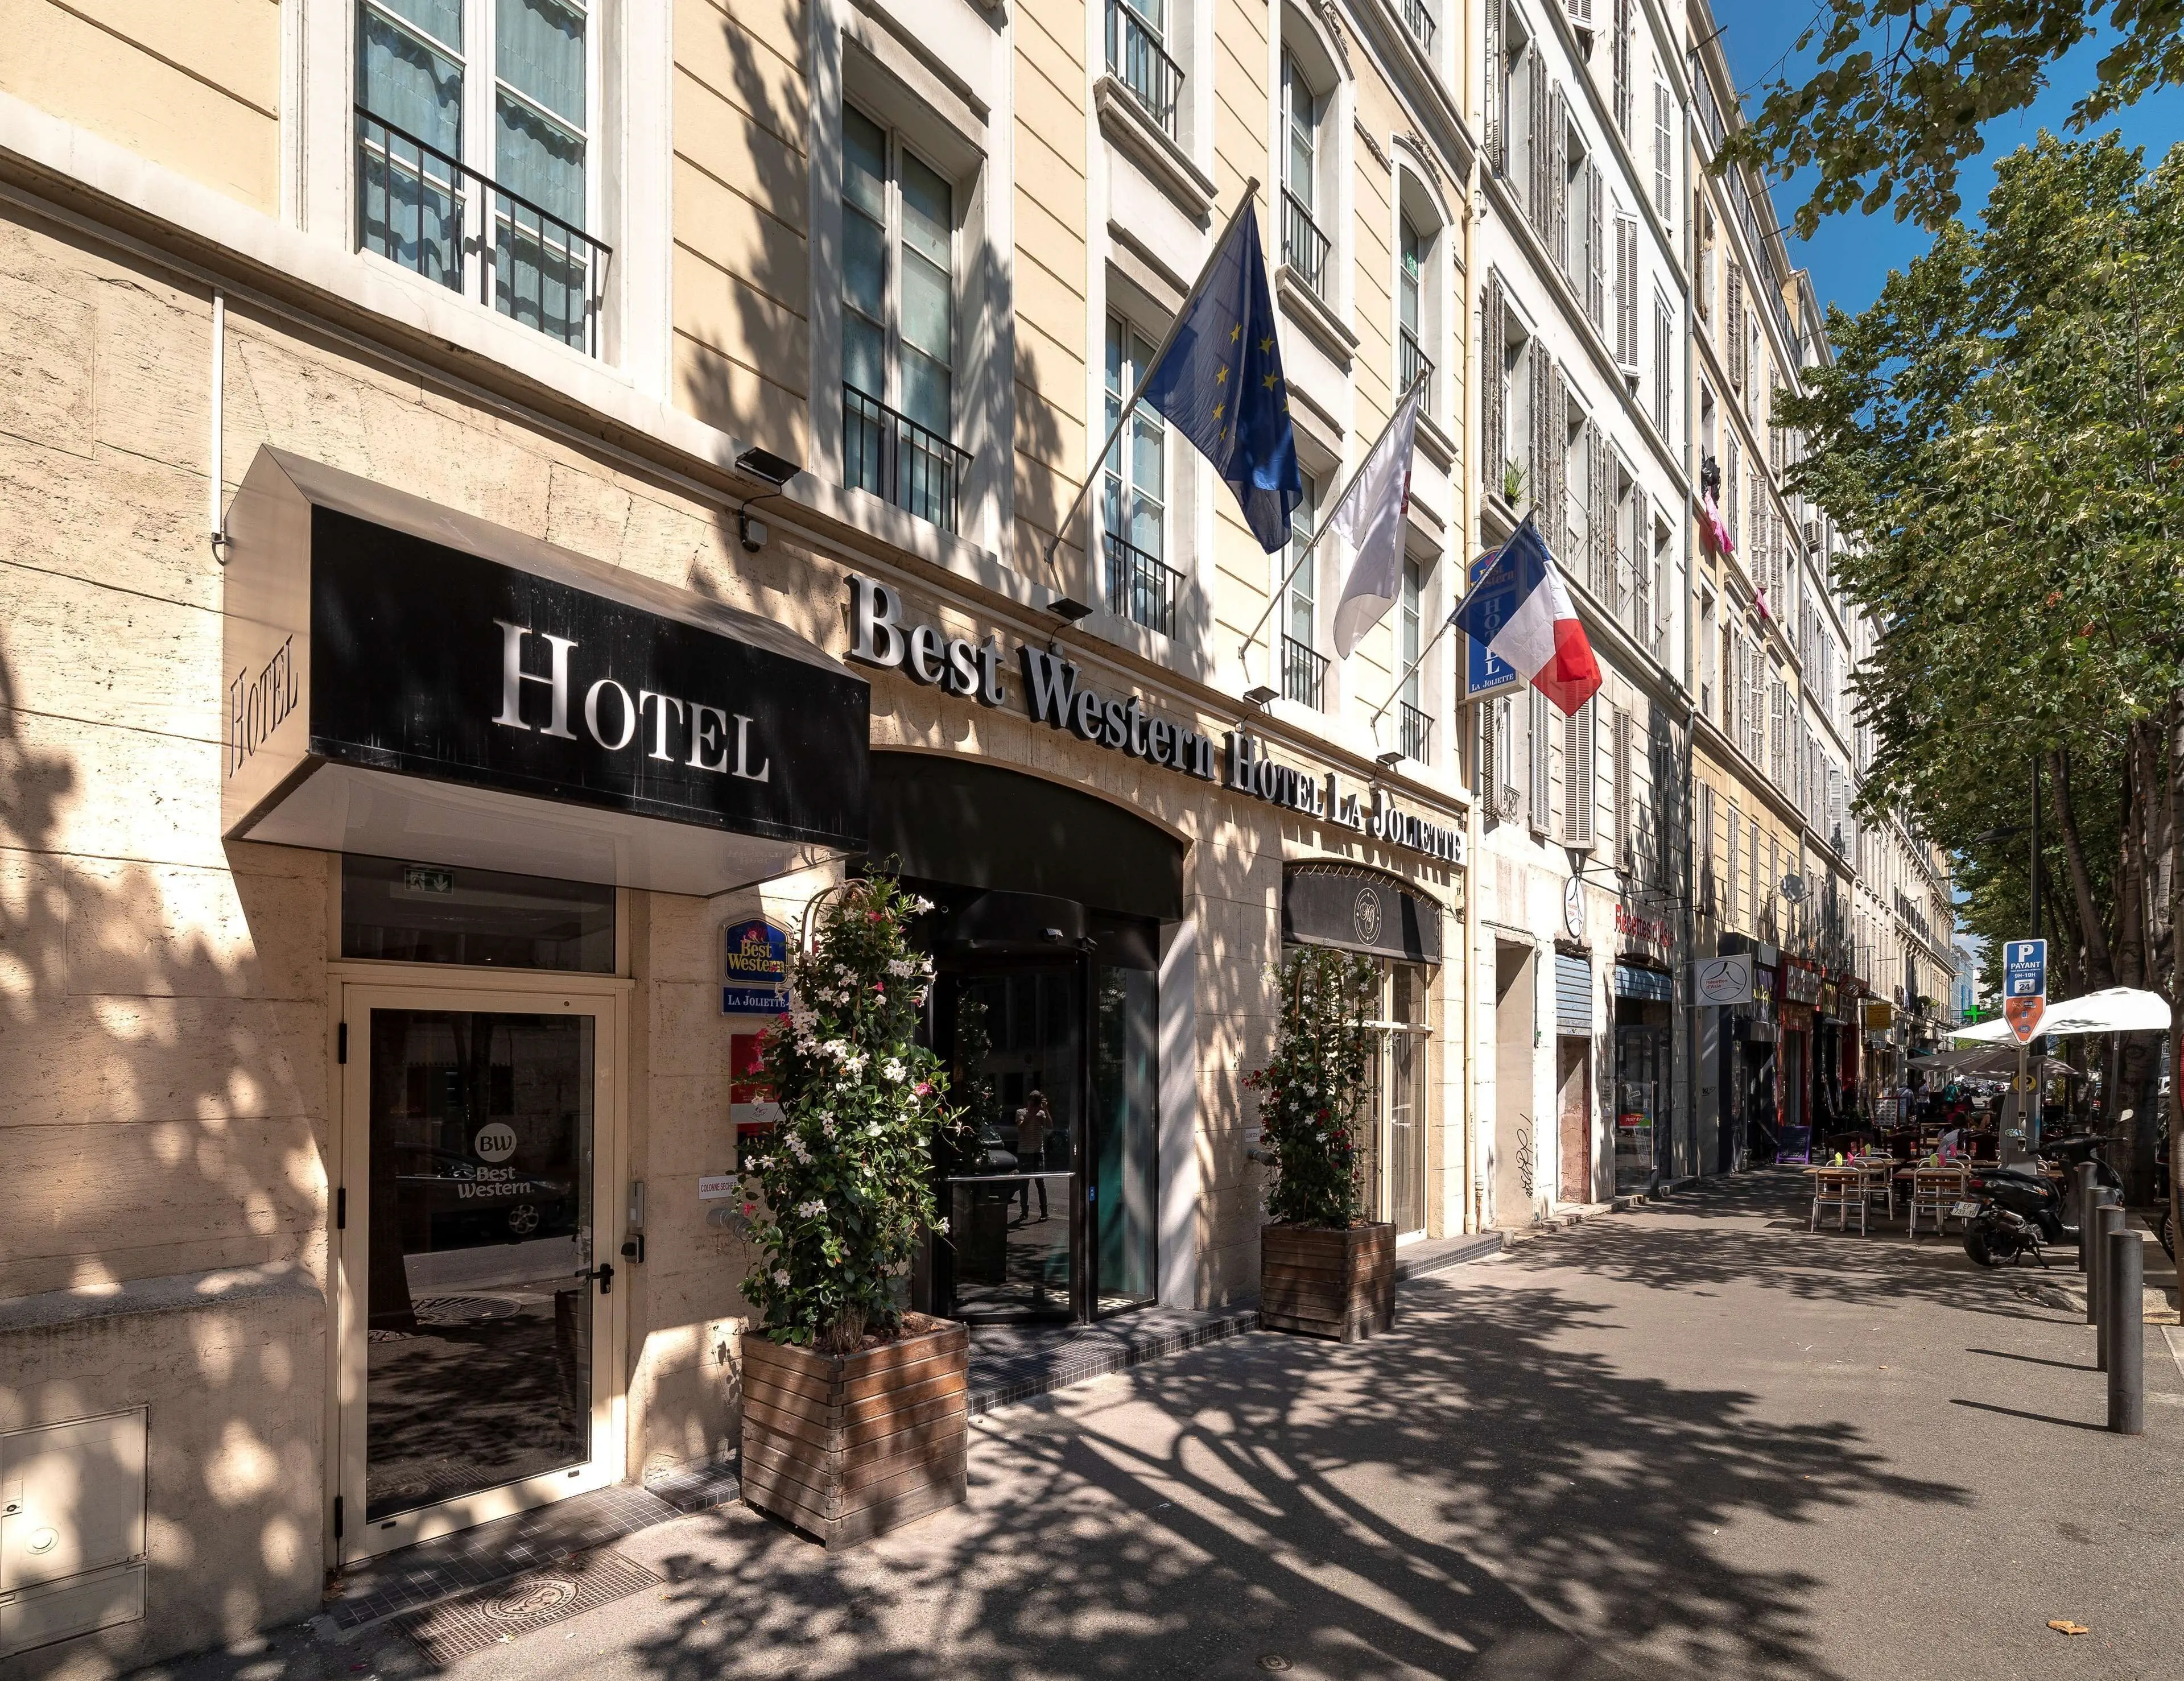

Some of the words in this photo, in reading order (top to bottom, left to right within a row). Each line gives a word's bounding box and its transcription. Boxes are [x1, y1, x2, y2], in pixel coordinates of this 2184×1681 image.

[1483, 674, 1514, 688] JOLIETTE
[229, 633, 298, 779] HOTEL
[492, 617, 769, 782] HOTEL
[844, 573, 1005, 707] Best
[1018, 643, 1216, 780] Western
[1223, 731, 1324, 817] HOTEL
[1368, 790, 1461, 862] JOLIETTE
[1616, 904, 1650, 939] Recettes
[741, 939, 771, 958] Best
[2018, 944, 2034, 962] P
[728, 953, 785, 973] Western
[744, 996, 786, 1007] JOLIETTE
[480, 1135, 513, 1152] BW
[476, 1166, 516, 1182] Best
[457, 1182, 531, 1199] Western
[701, 1183, 720, 1192] COLONNE
[720, 1182, 733, 1191] SECHE
